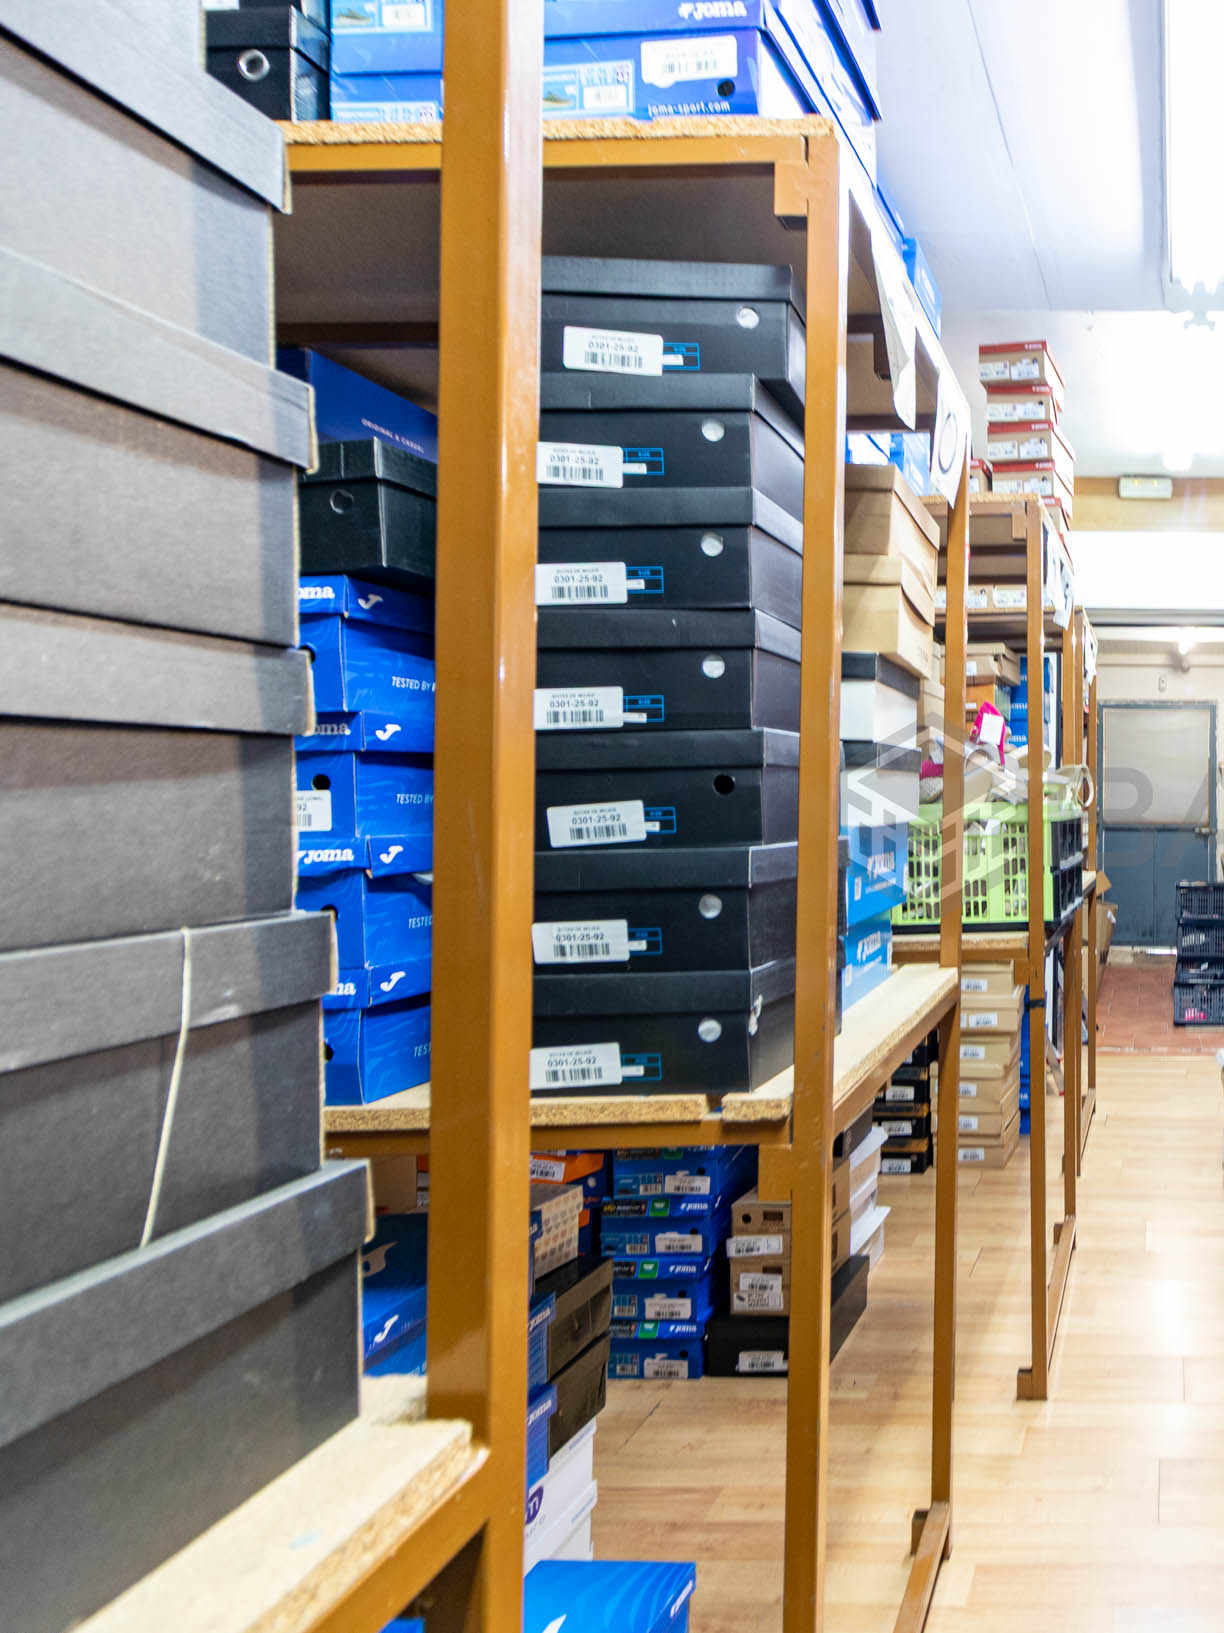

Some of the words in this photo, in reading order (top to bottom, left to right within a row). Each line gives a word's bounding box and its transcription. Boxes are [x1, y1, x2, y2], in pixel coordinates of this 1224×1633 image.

[648, 101, 731, 116] joma-sport.com
[588, 341, 639, 353] 0301-25-92
[550, 455, 600, 465] 0301-25-92
[554, 575, 604, 584] 0301-25-92
[296, 586, 335, 600] oma
[391, 676, 420, 691] TESTED
[549, 699, 599, 708] 0301-25-92
[314, 723, 351, 736] oma
[396, 793, 423, 805] TESTED
[571, 814, 621, 825] 0301-25-92
[555, 933, 605, 943] 0301-25-92
[547, 1056, 597, 1067] 0301-25-92
